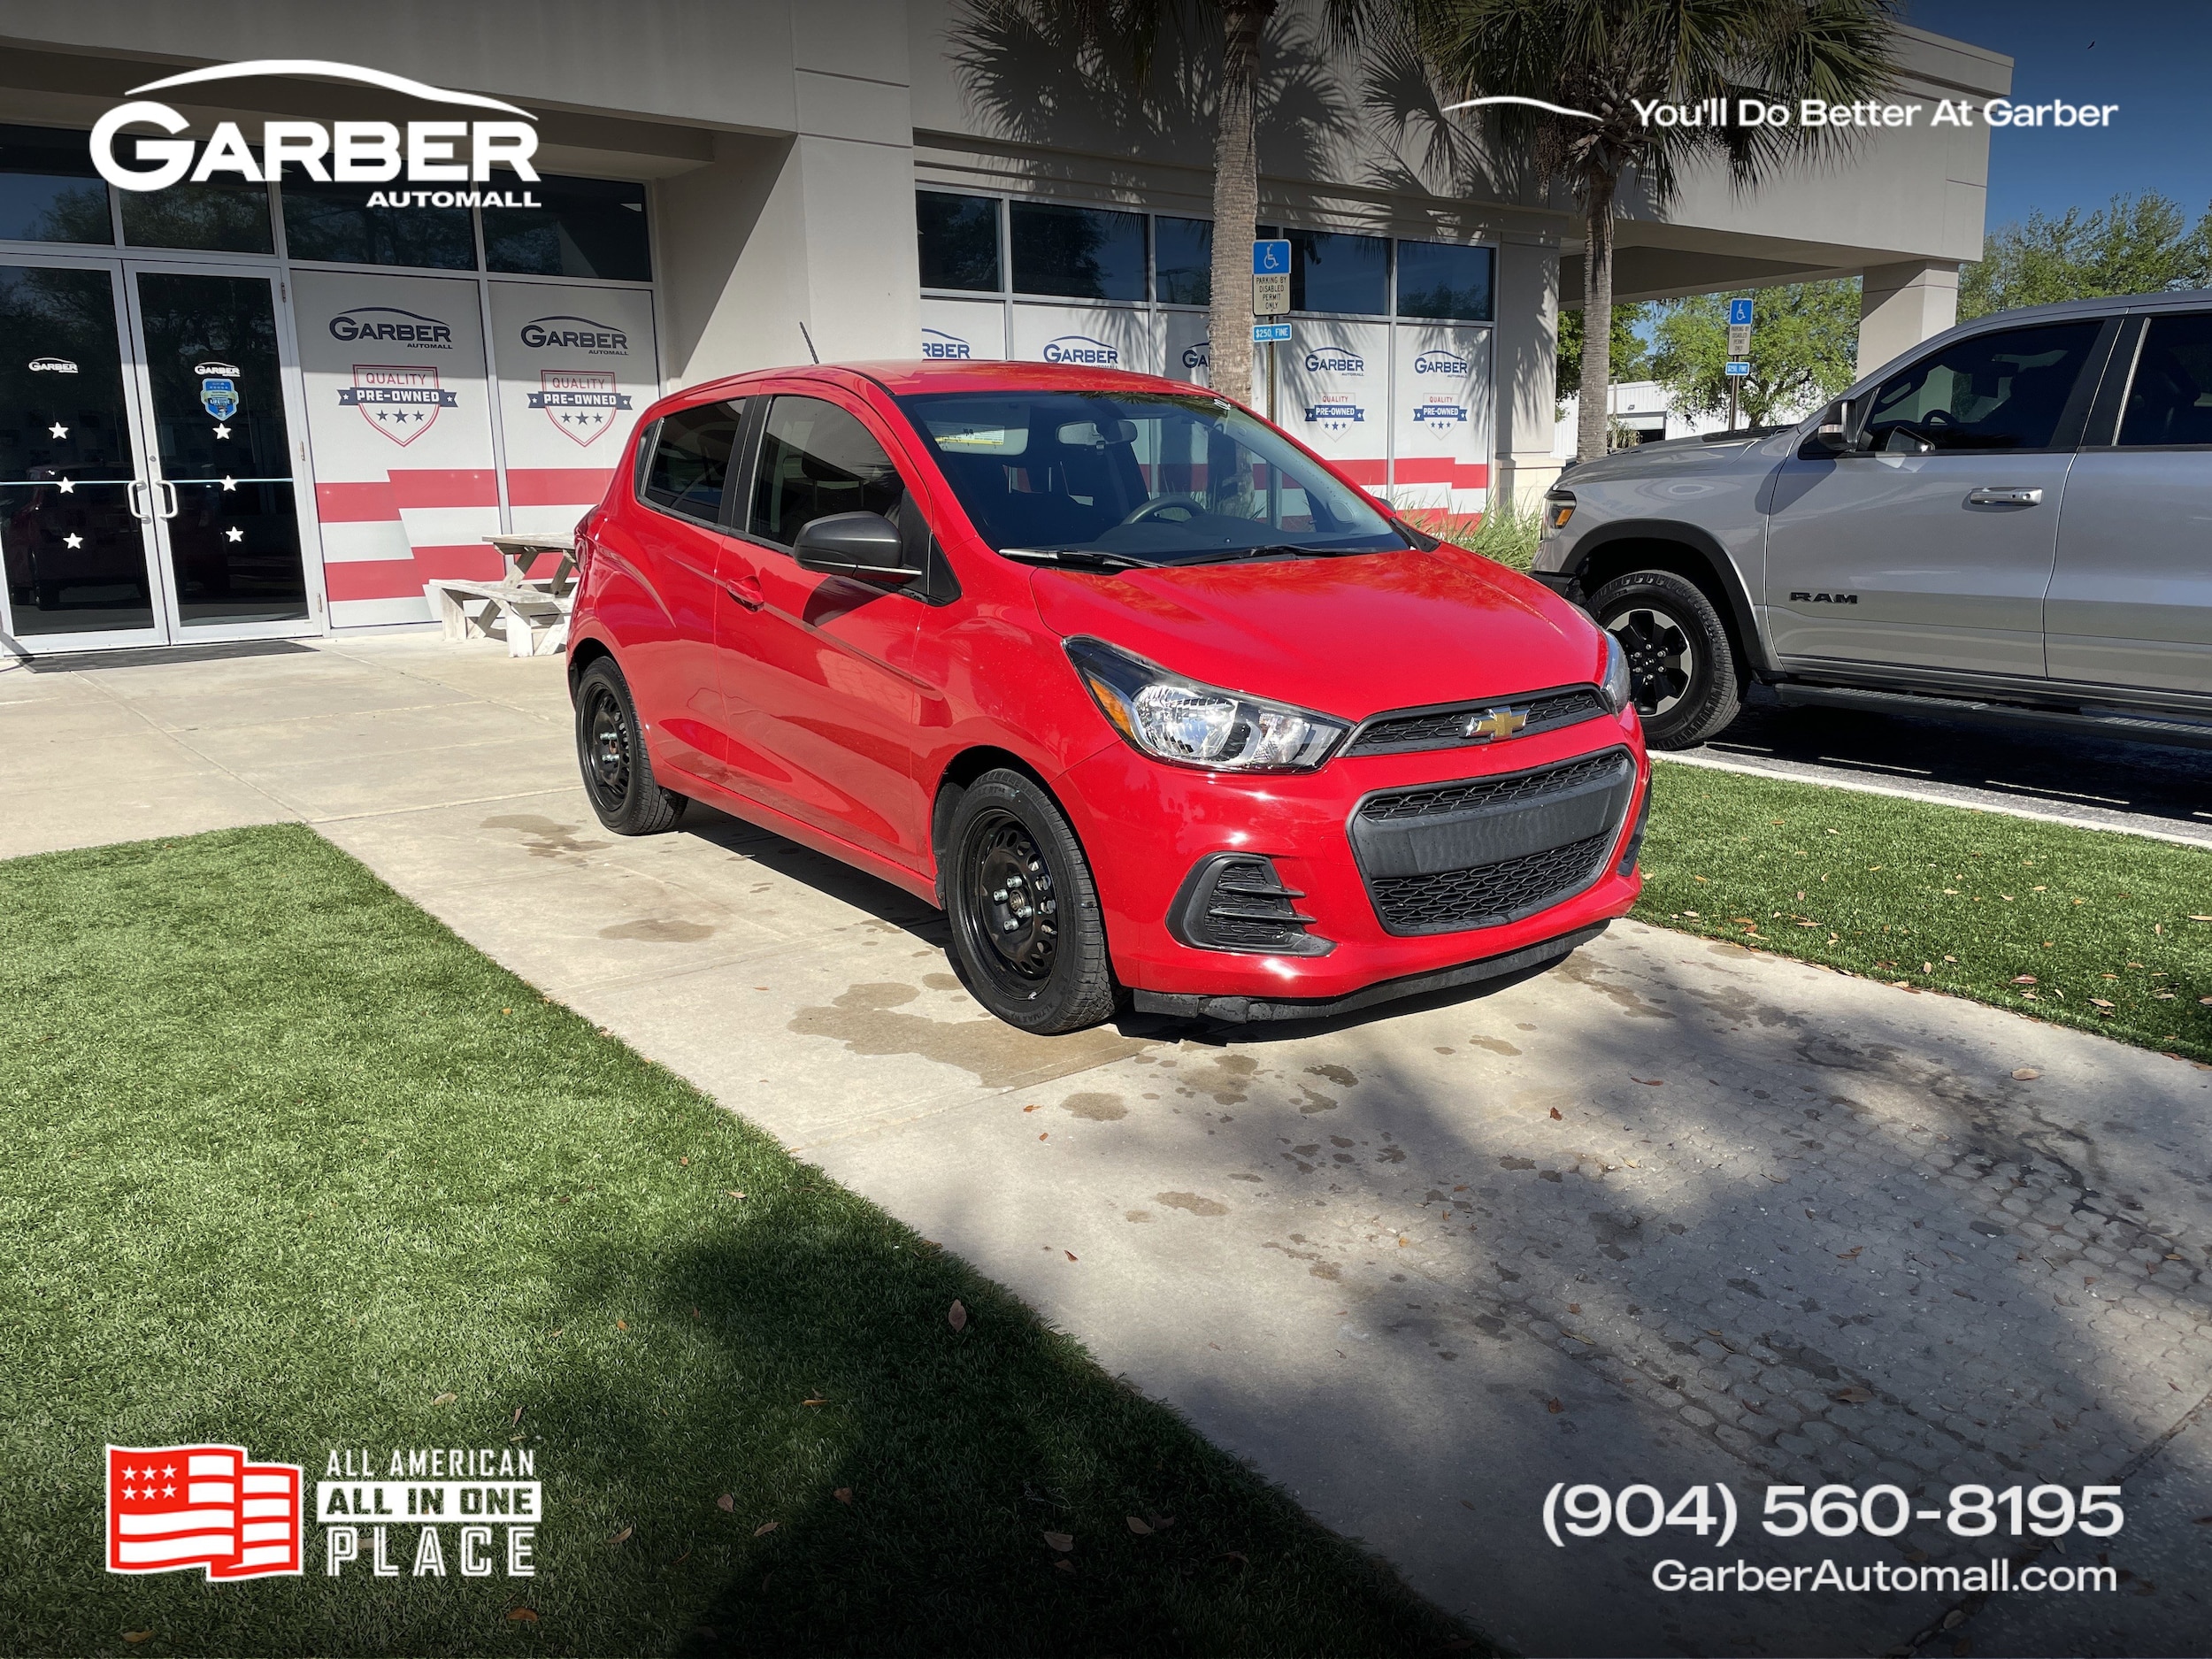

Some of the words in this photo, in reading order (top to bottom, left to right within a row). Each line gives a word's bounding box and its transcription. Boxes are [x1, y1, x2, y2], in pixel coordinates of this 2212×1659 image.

[329, 316, 452, 342] GARBER
[1275, 327, 1289, 337] FINE
[520, 325, 628, 349] GARBER
[922, 342, 971, 359] RBER
[1043, 343, 1118, 365] GARBER
[28, 361, 78, 372] GARBER
[1305, 354, 1364, 373] GARBER
[1415, 357, 1468, 373] GARBER
[365, 373, 426, 386] QUALITY
[552, 378, 605, 389] QUALITY
[356, 389, 440, 403] PRE-OWNED
[543, 394, 617, 405] PRE-OWNED
[1316, 407, 1355, 416] PRE-OWNED
[1423, 407, 1459, 416] PRE-OWNED
[1790, 592, 1857, 604] RAM
